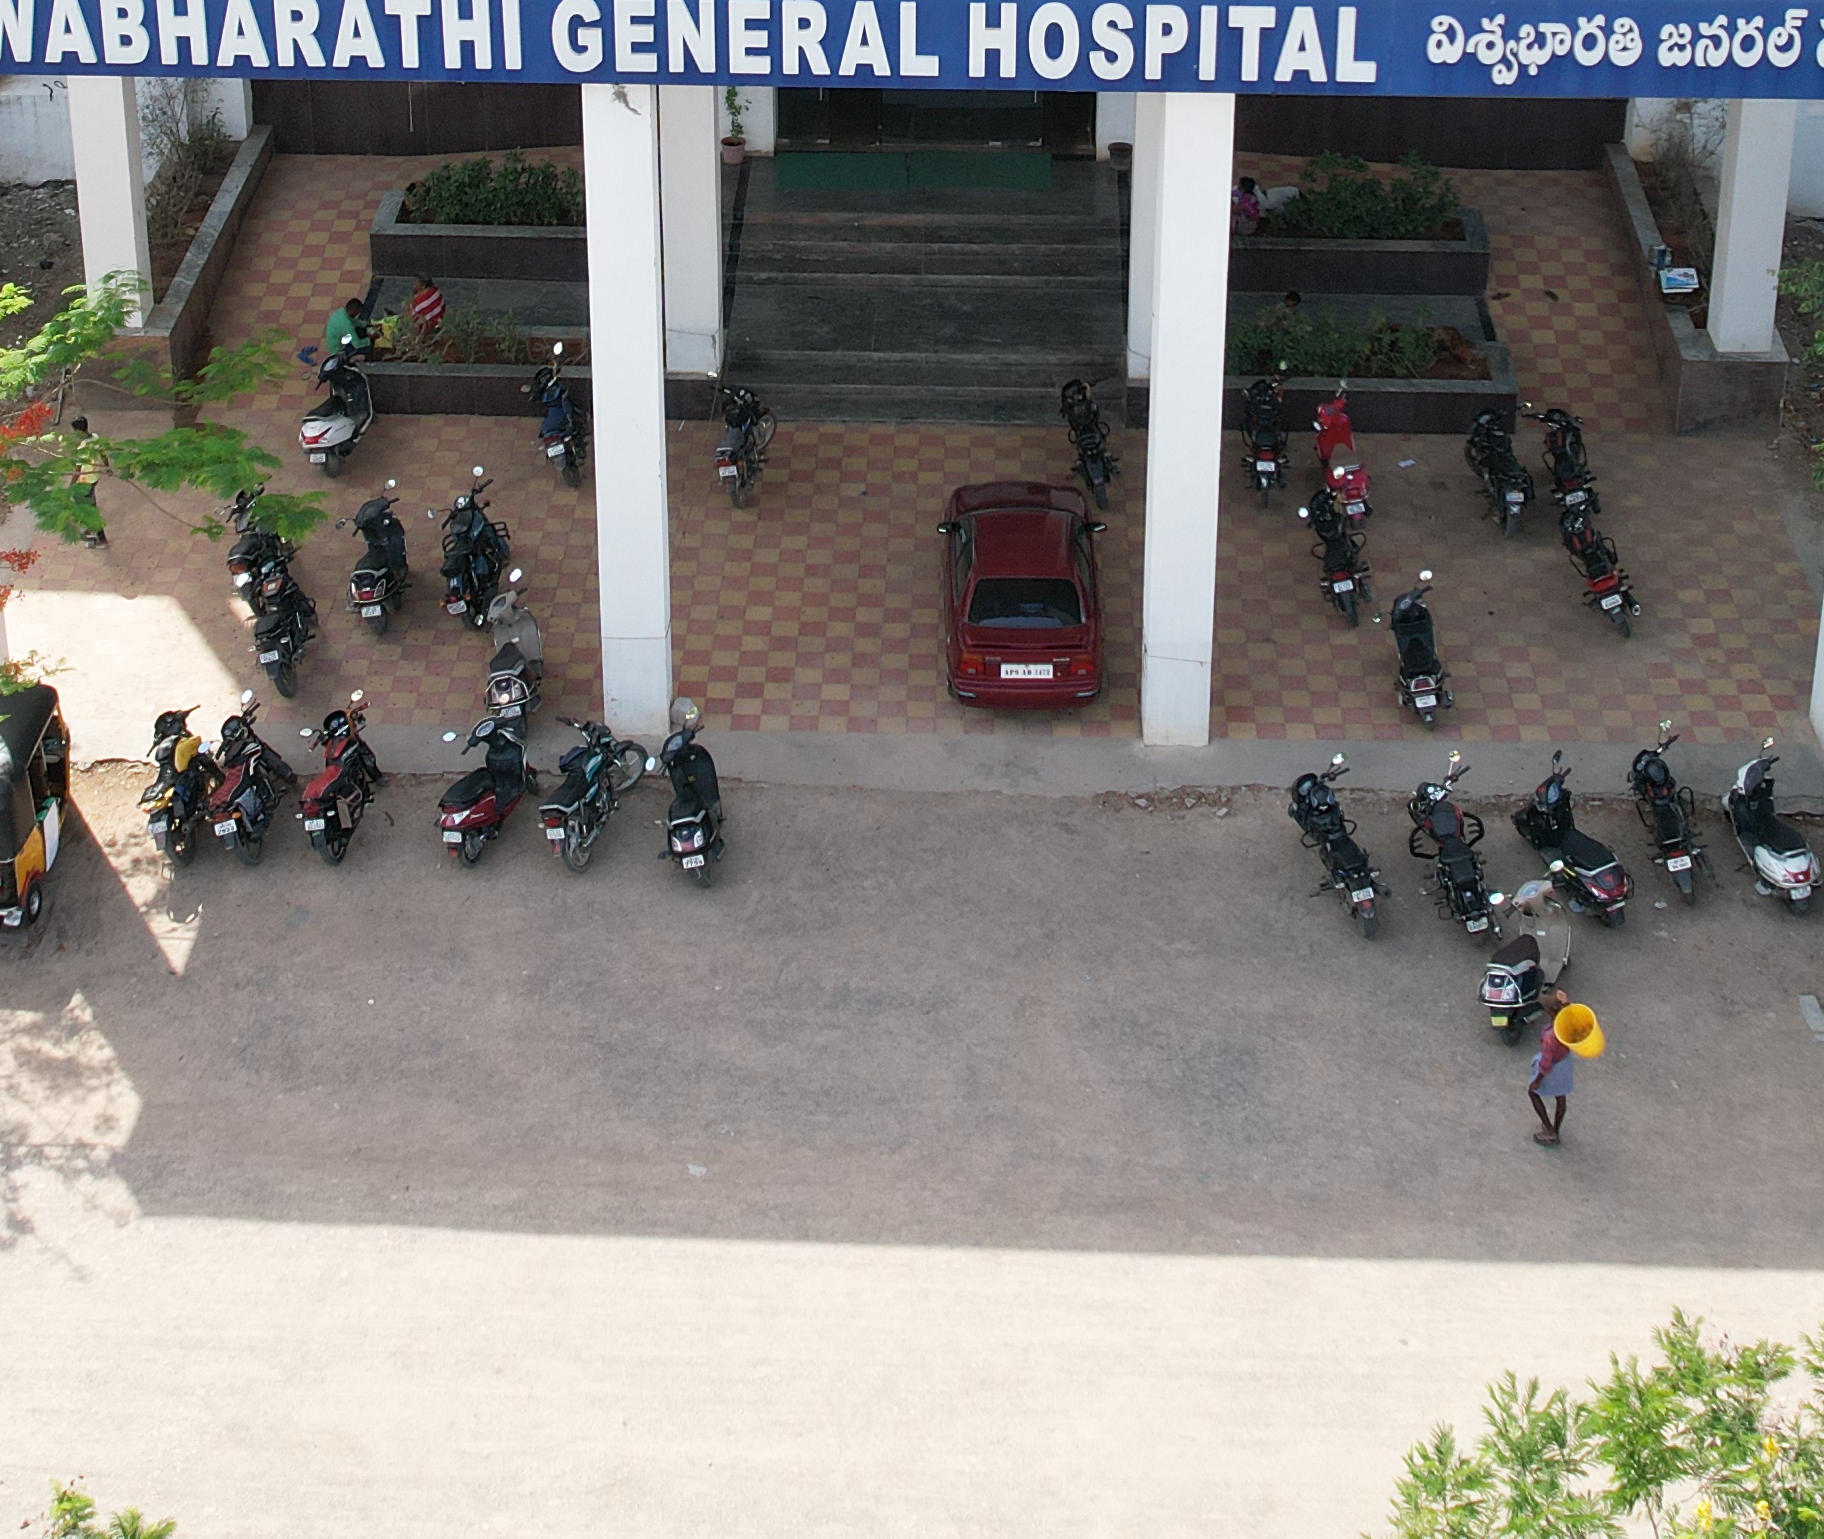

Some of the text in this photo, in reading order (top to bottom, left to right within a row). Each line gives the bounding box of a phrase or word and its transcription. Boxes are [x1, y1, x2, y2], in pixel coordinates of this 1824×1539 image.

[969, 2, 1376, 82] HOSPITAL
[1427, 13, 1643, 85] విశ్వభారతి
[1657, 8, 1809, 68] జనరల్
